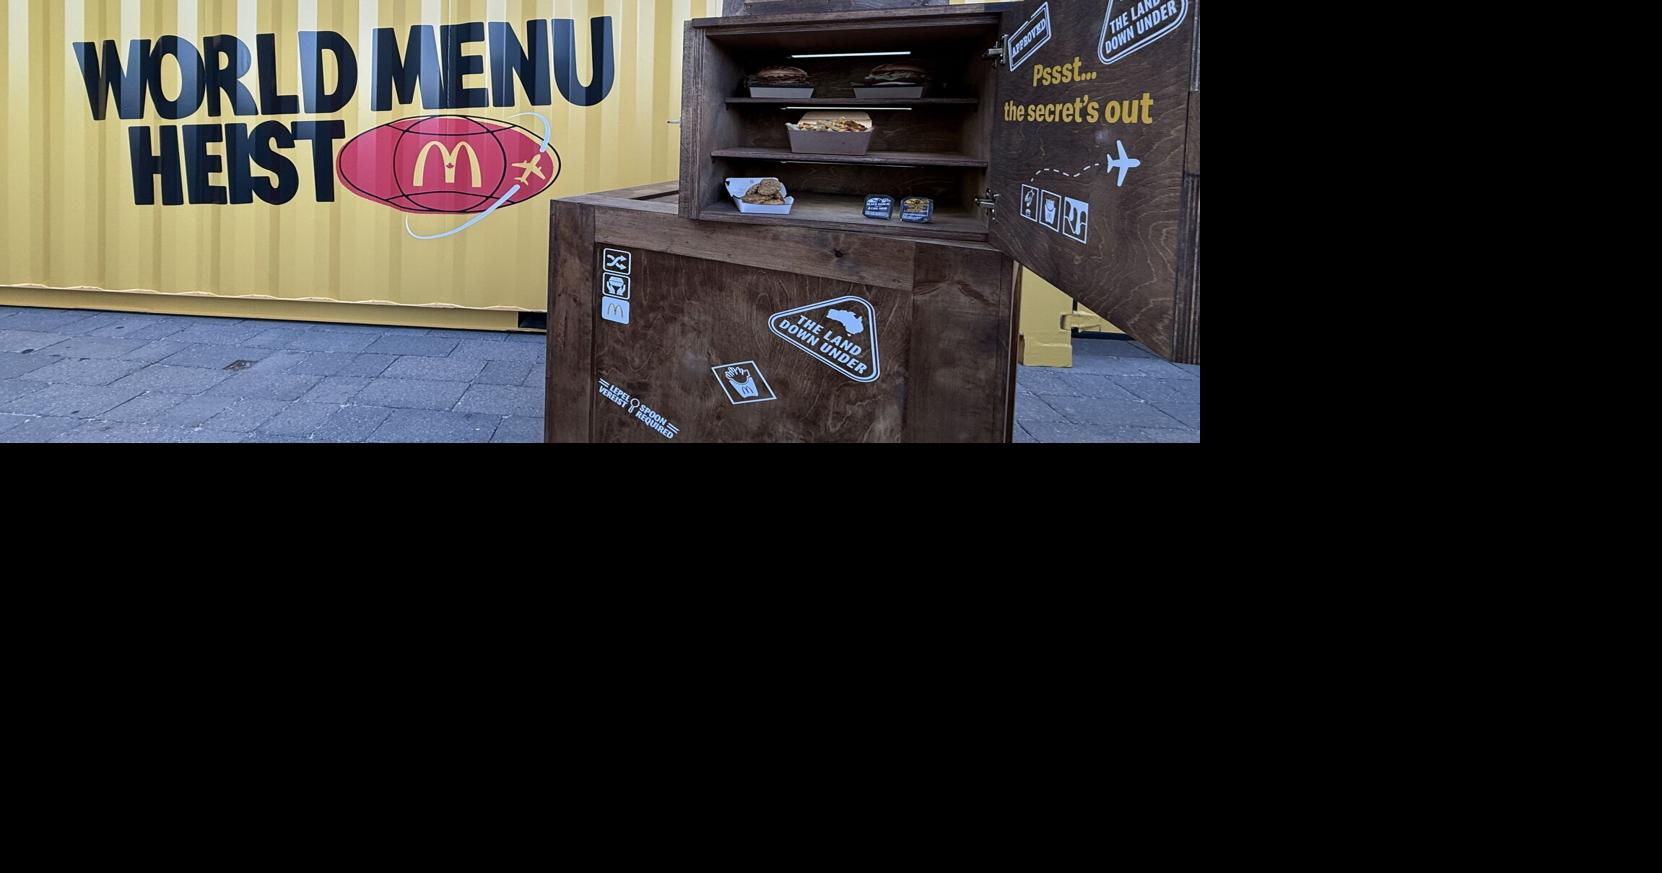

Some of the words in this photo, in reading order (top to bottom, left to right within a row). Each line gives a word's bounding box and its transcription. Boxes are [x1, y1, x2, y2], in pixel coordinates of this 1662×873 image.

[1011, 18, 1046, 58] APPROVED
[1105, 26, 1135, 54] DOWN
[1136, 0, 1177, 35] UNDER
[1109, 12, 1129, 34] THE
[72, 31, 359, 121] WORLD
[371, 16, 615, 112] MENU
[1033, 56, 1097, 87] Pssst...
[1004, 100, 1025, 121] the
[1027, 94, 1099, 124] secret's
[1105, 92, 1154, 125] out
[128, 120, 346, 206] HEIST
[779, 319, 820, 346] DOWN
[820, 342, 868, 374] UNDER
[797, 315, 824, 335] THE
[823, 330, 862, 356] LAND
[599, 385, 628, 408] VEREIST
[609, 384, 631, 402] LEPEL
[635, 411, 674, 439] REQUIRED
[639, 404, 668, 426] SPOON
